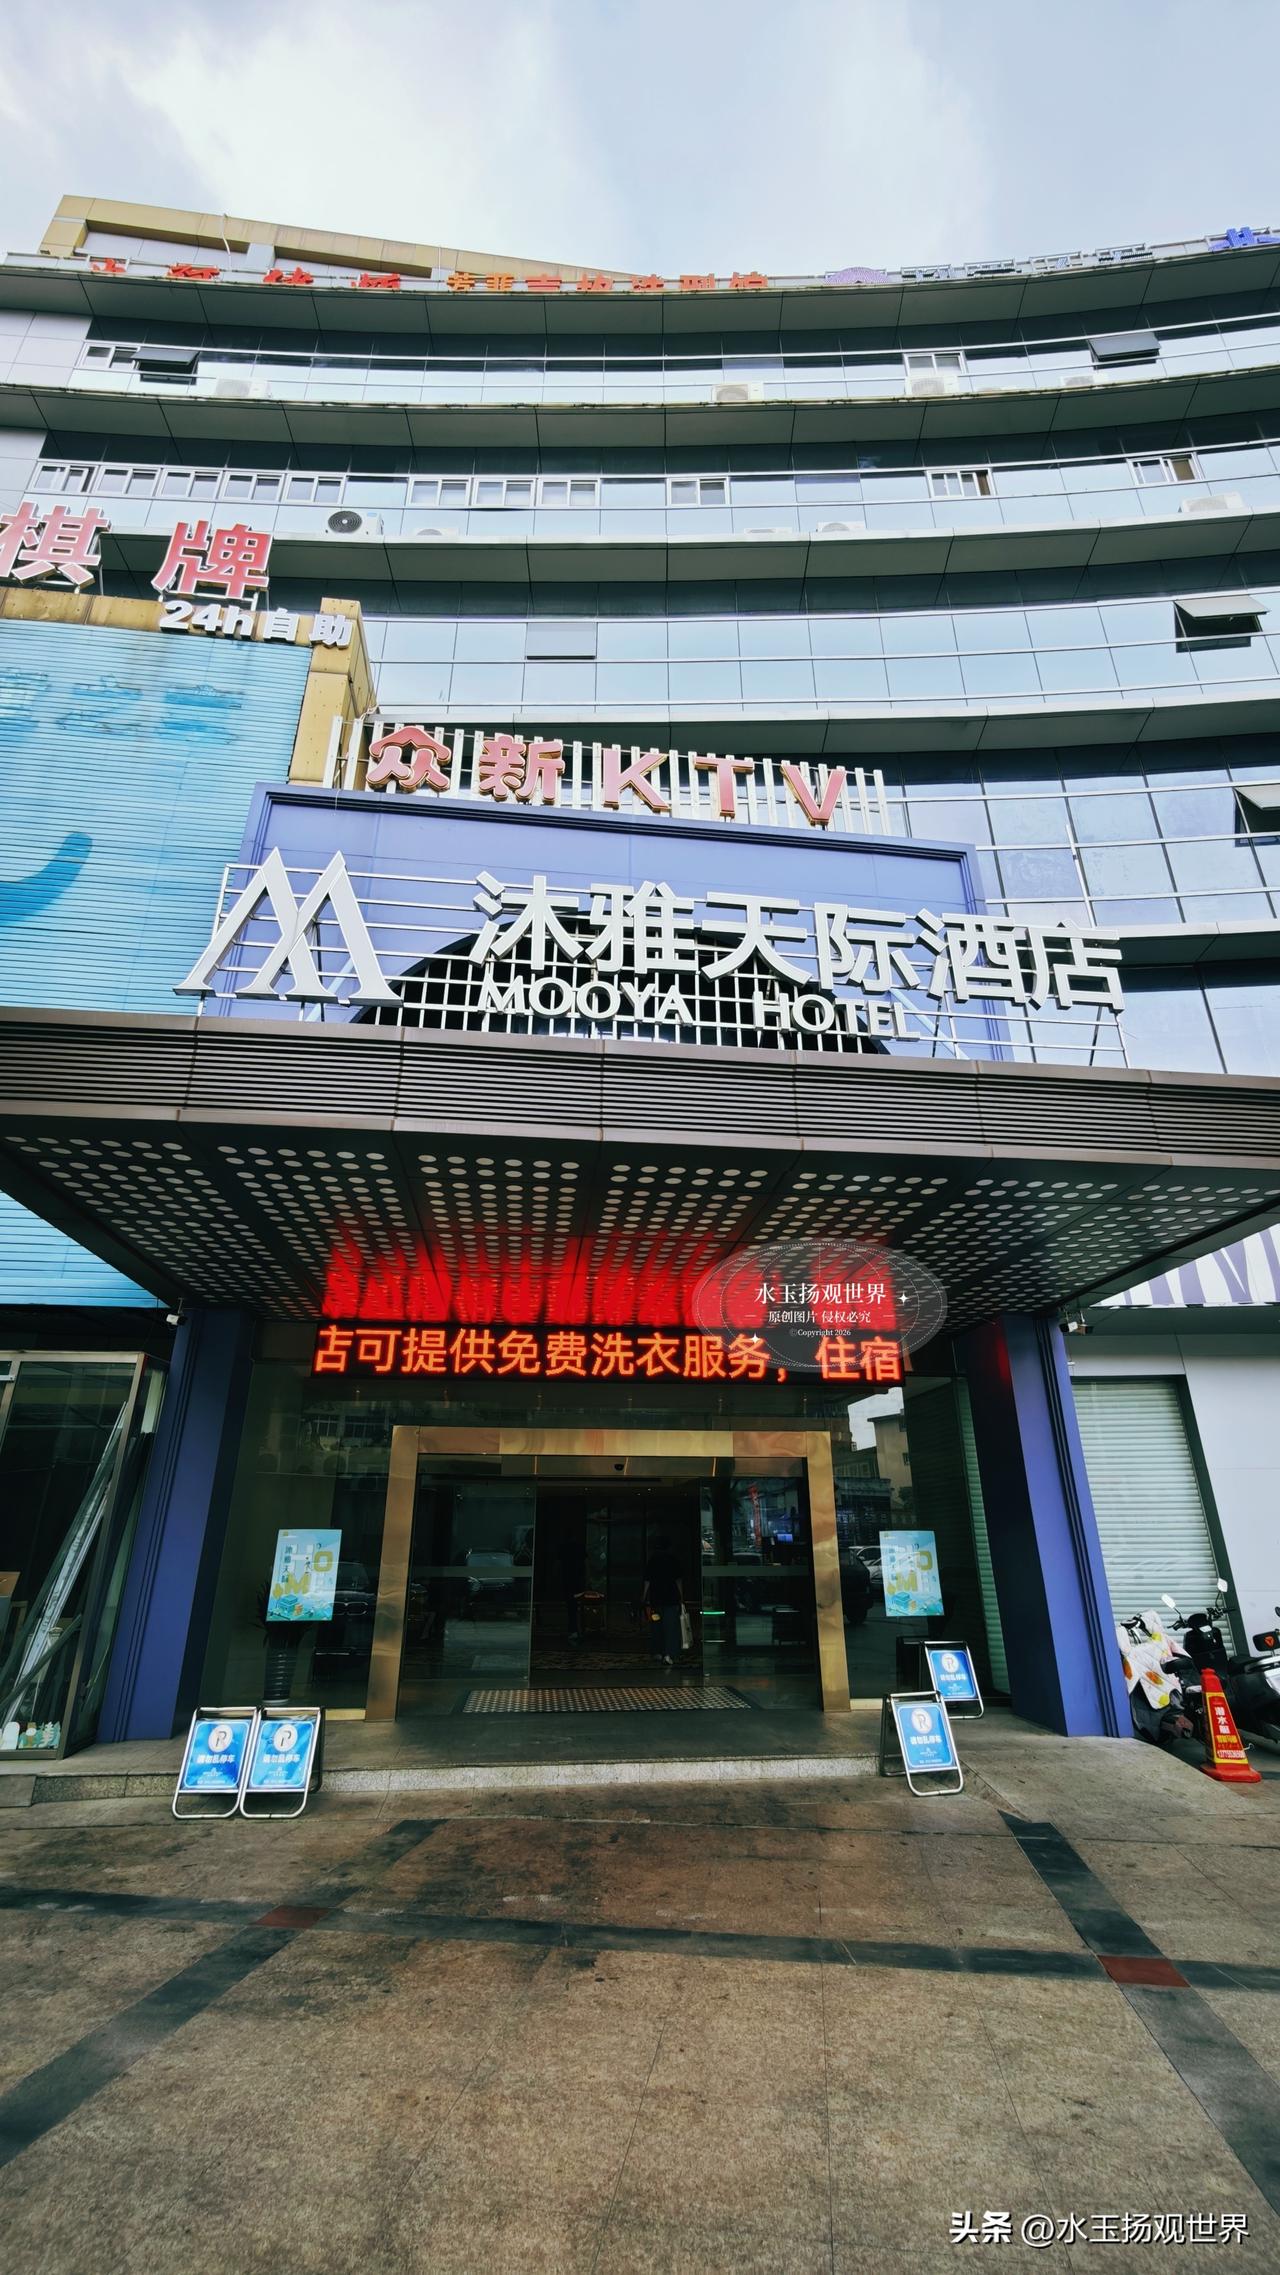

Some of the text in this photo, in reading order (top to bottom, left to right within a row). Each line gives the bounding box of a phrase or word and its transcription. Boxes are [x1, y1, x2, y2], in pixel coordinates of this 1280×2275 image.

[0, 502, 273, 599] 棋牌
[159, 600, 353, 649] 24h自助
[469, 871, 1124, 1012] 沐雅天际酒店
[478, 975, 920, 1041] MOOYA HOTEL
